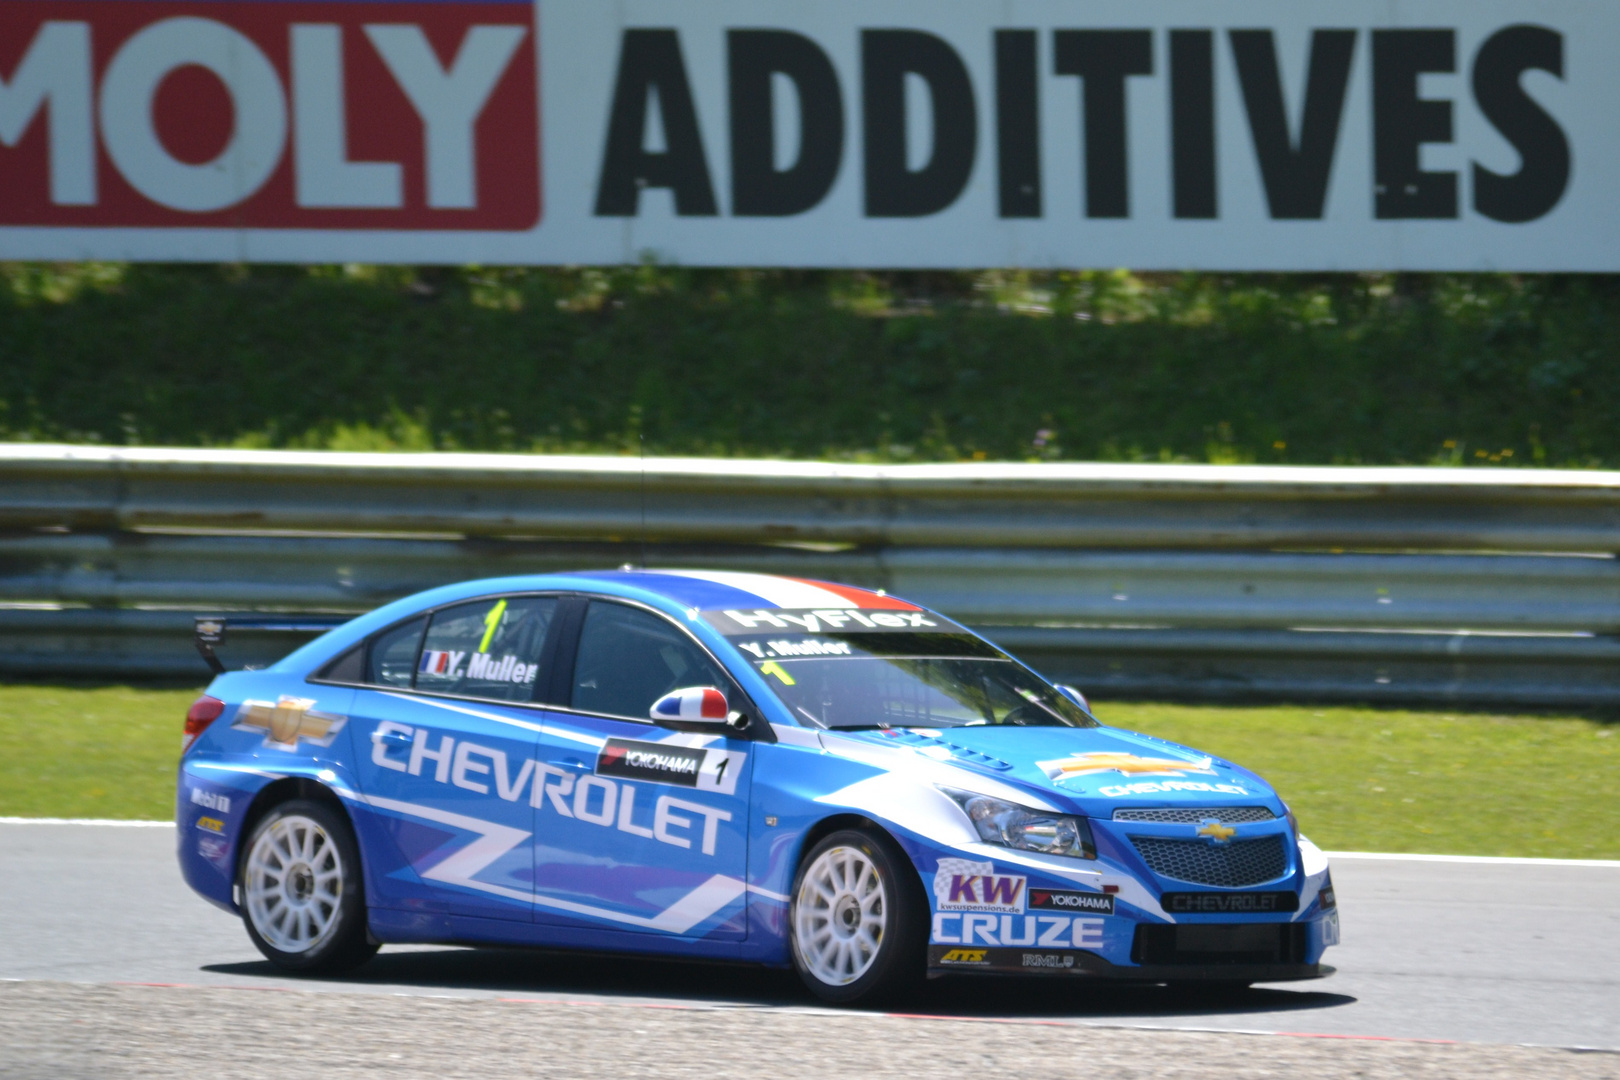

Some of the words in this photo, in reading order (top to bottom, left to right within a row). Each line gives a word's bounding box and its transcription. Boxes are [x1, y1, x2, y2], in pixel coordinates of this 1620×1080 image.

[592, 23, 1574, 224] ADDITIVES
[478, 599, 508, 654] 1
[723, 609, 938, 633] HyFlex
[767, 639, 852, 656] Muller
[446, 651, 465, 677] Y.
[466, 652, 539, 684] Muller
[760, 660, 796, 686] 1
[624, 750, 699, 775] YOKOHAMA
[715, 757, 730, 786] 1
[371, 720, 733, 857] CHEVROLET
[1098, 781, 1250, 798] CHEVROLET
[948, 874, 1026, 906] KW
[1051, 894, 1112, 911] YOKOHAMA
[1171, 894, 1279, 911] CHEVROLET
[940, 902, 1021, 914] kwsuspensions.de
[931, 912, 1105, 949] CRUZE
[940, 949, 989, 962] ATS
